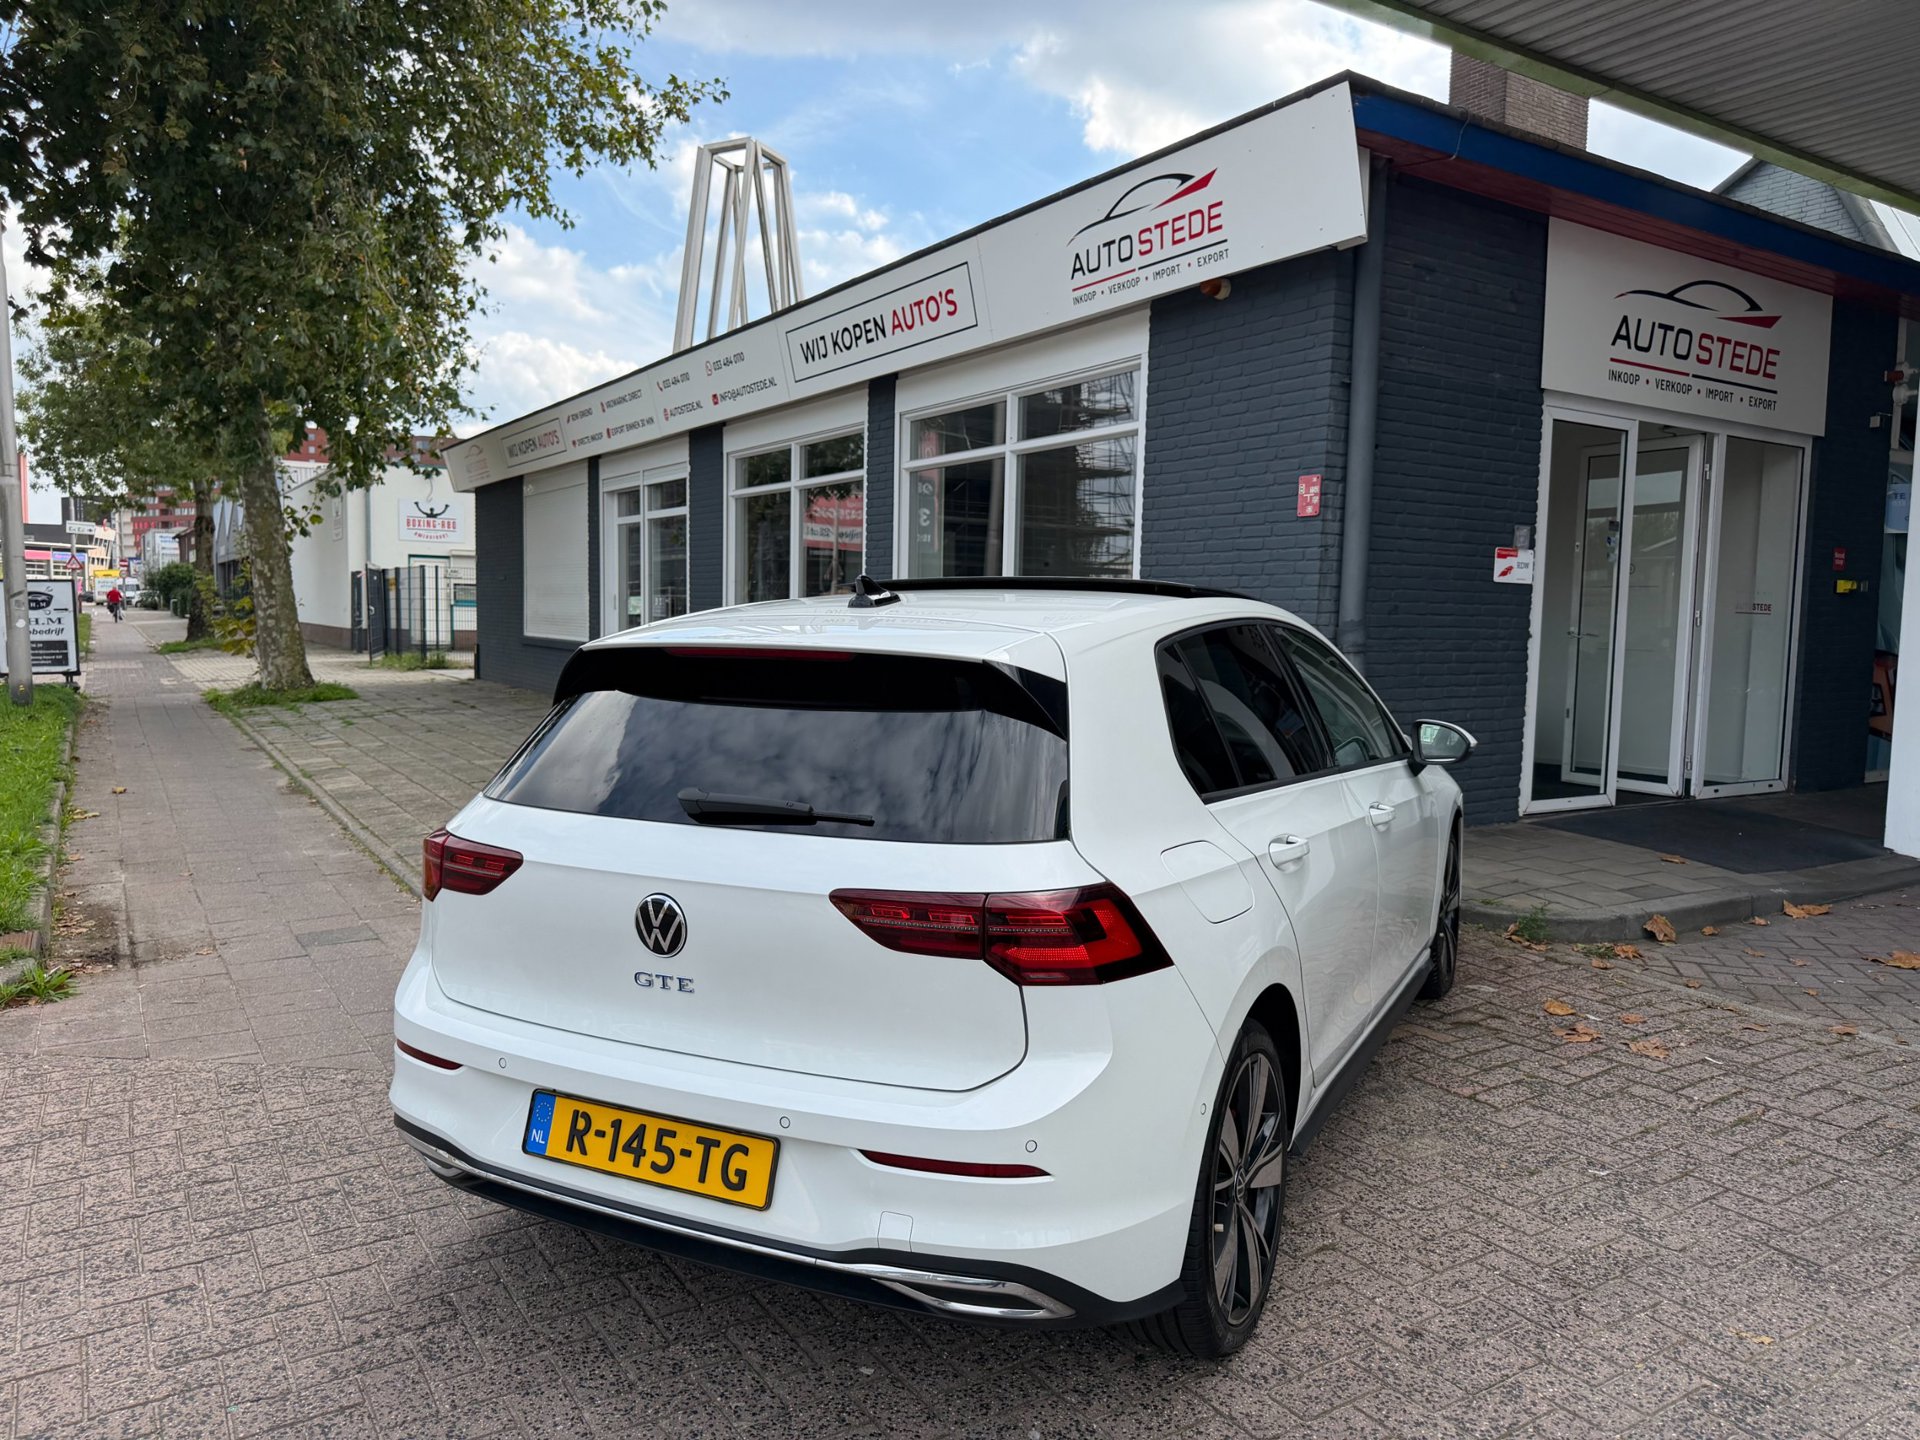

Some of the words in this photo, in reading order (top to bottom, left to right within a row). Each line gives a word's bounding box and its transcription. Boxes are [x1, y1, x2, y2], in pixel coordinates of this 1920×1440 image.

[1072, 290, 1097, 305] INKOOP
[1107, 276, 1141, 295] VERKOOP
[1152, 264, 1181, 281] IMPORT
[1197, 248, 1229, 268] EXPORT
[800, 335, 828, 364] WIJ
[831, 314, 887, 355] KOPEN
[891, 288, 958, 336] AUTO'S
[719, 376, 777, 402] INFO@AUTOSTEDE.NL
[1608, 369, 1640, 385] INKOOP
[1655, 377, 1693, 395] VERKOOP
[1705, 387, 1734, 403] IMPORT
[1748, 396, 1777, 411] EXPORT
[669, 400, 703, 417] AUTOSTEDE.NL
[518, 436, 538, 455] KOPEN
[537, 429, 560, 449] AUTO'S
[634, 971, 695, 993] GTE
[530, 1129, 546, 1144] NL
[565, 1109, 750, 1192] R-145-TG
